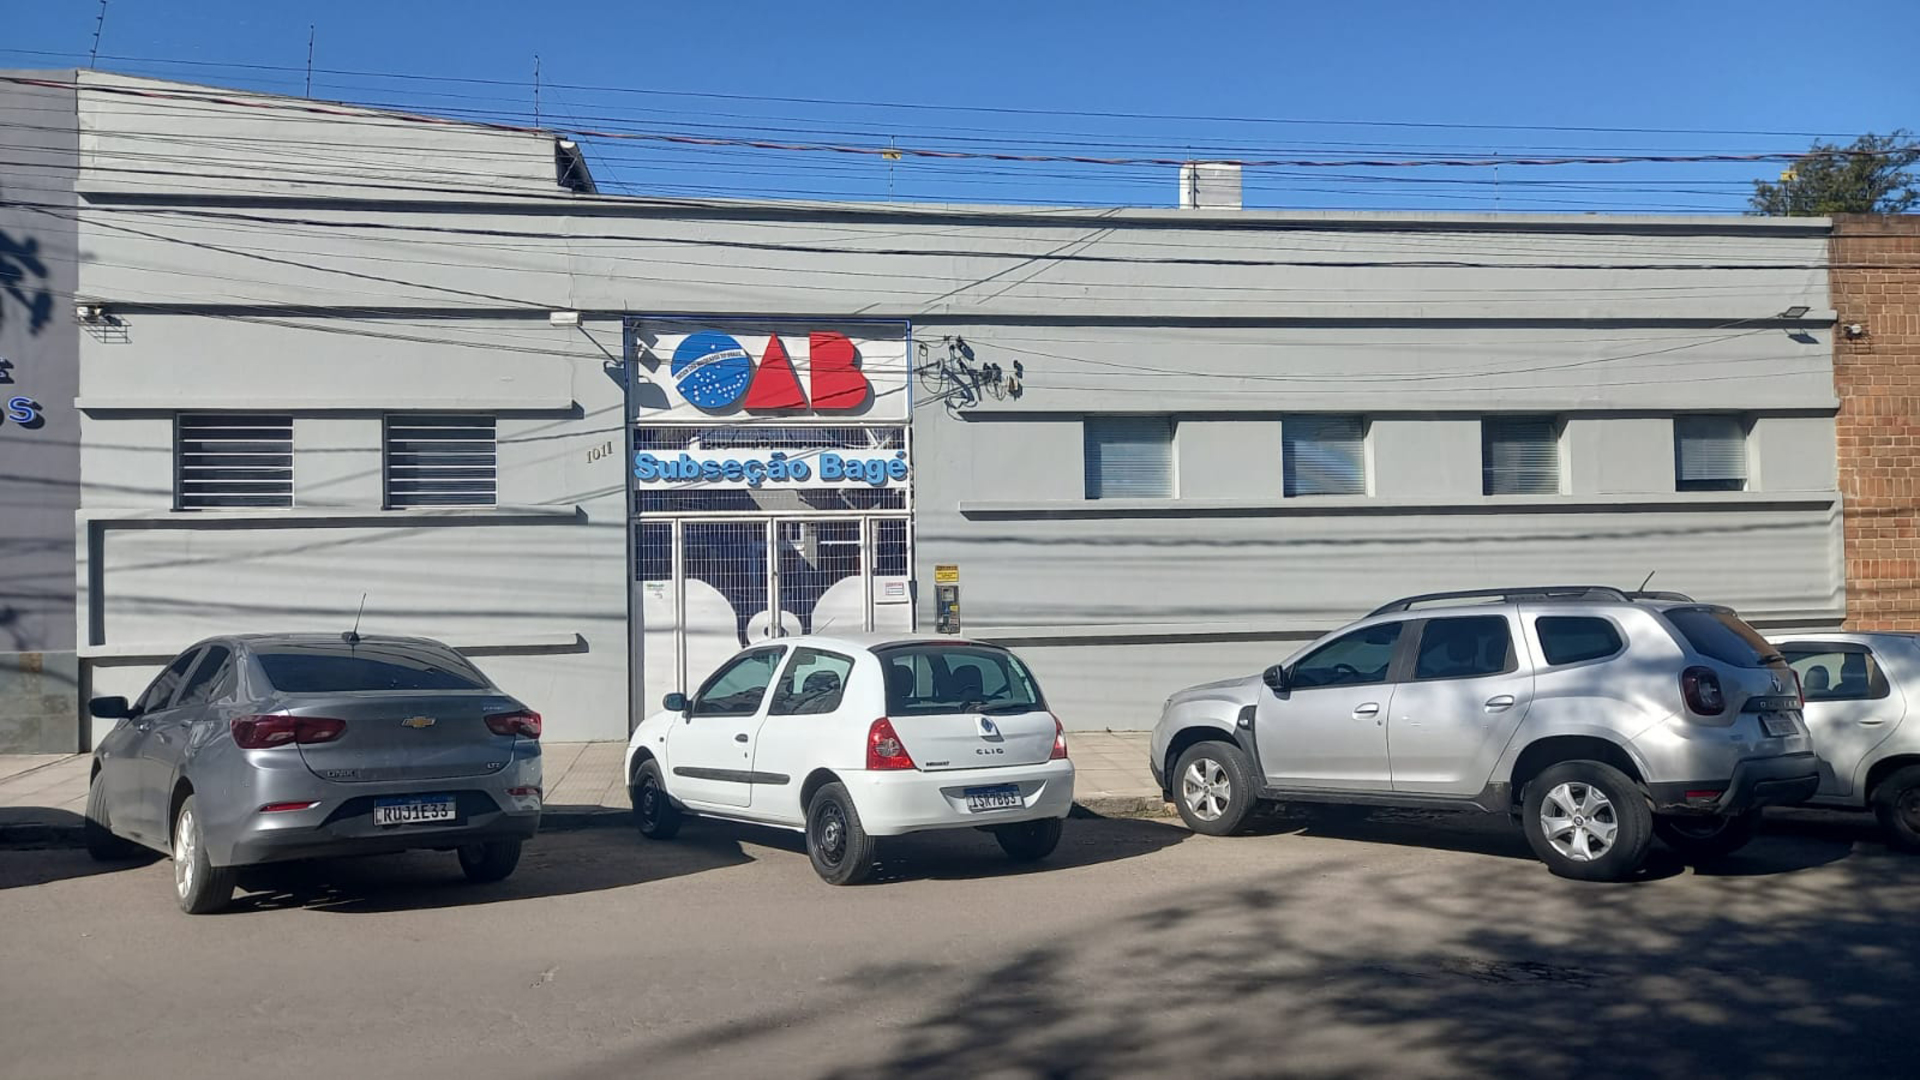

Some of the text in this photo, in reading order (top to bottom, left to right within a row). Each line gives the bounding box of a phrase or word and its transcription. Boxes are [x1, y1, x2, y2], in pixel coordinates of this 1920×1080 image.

[586, 441, 613, 464] 1011
[634, 450, 908, 485] Subseção Bagé
[383, 803, 448, 822] RUJ1E33
